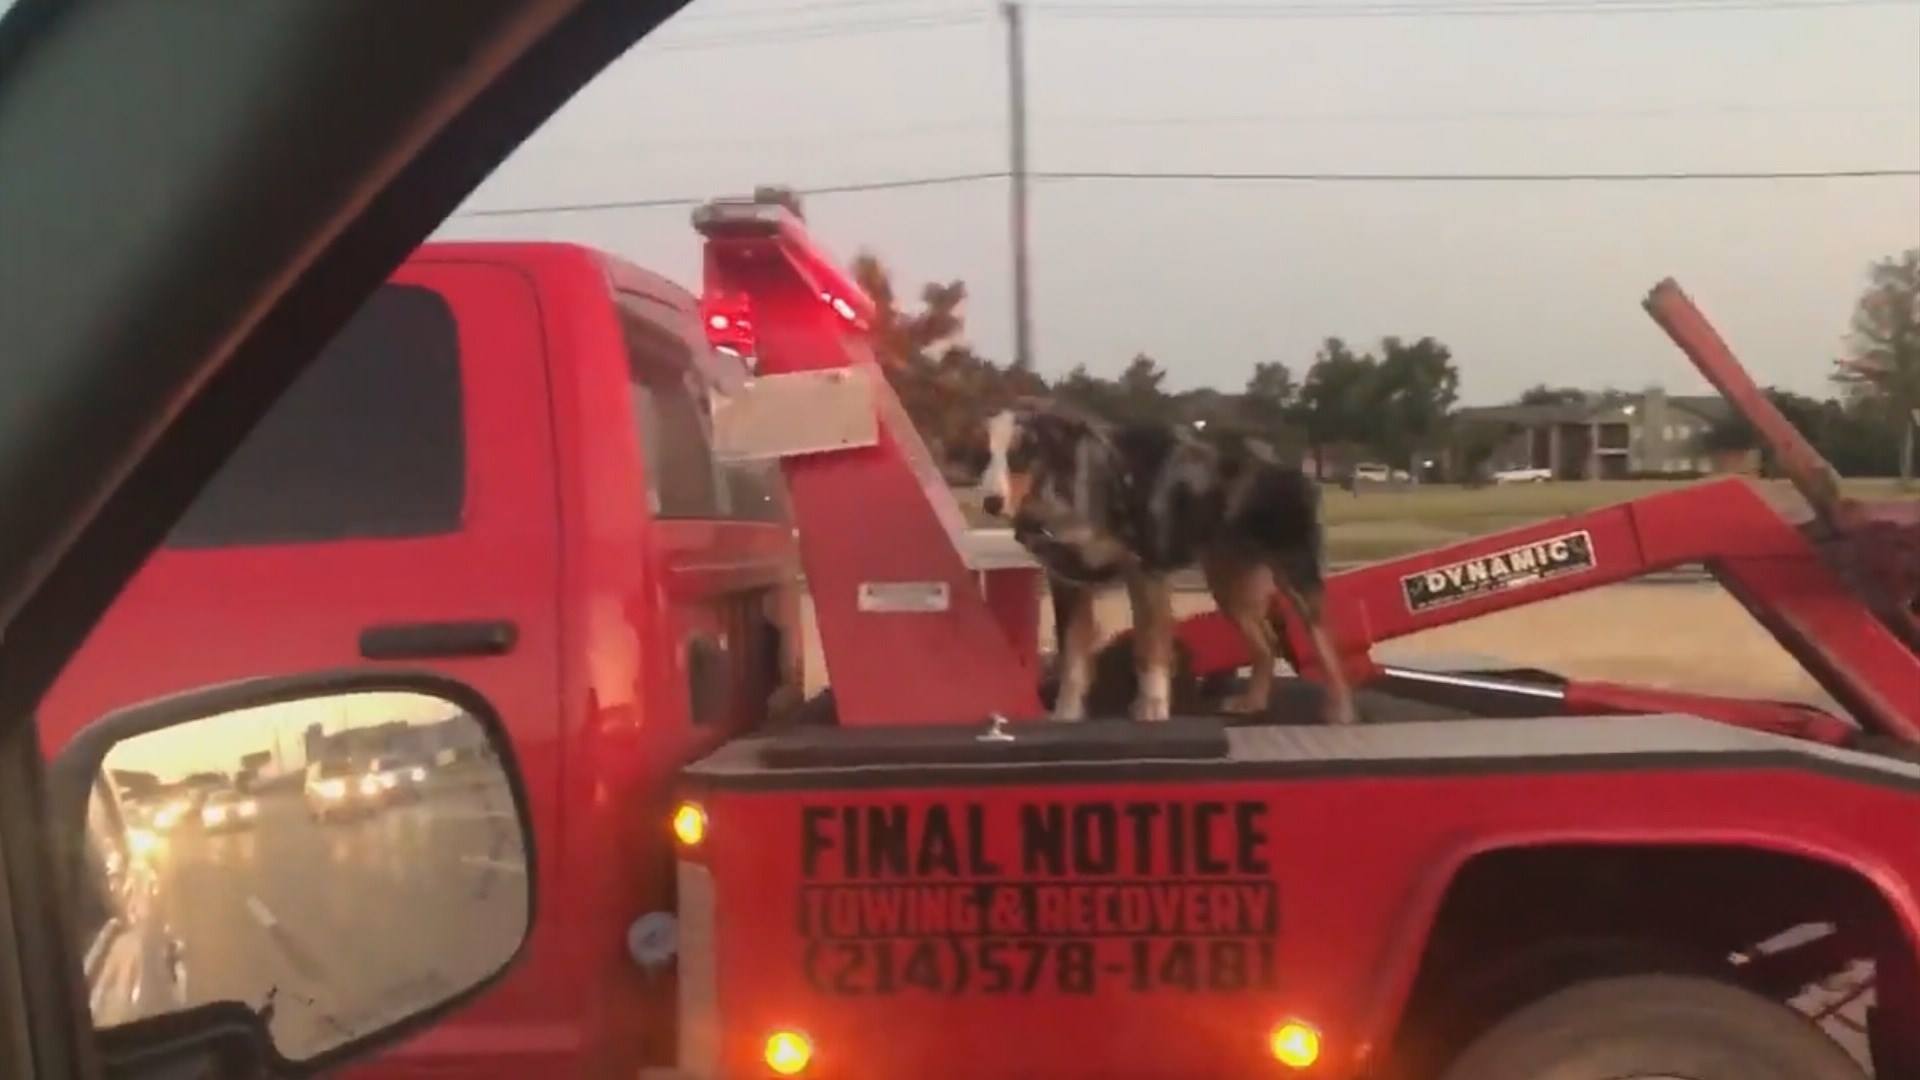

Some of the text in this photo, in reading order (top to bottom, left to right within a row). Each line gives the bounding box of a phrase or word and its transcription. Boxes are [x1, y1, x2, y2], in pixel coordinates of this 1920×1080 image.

[1424, 540, 1570, 593] DYNAMIC
[801, 801, 1270, 878] FINAL NOTICE
[804, 884, 1274, 935] TOWING & RECOVERY
